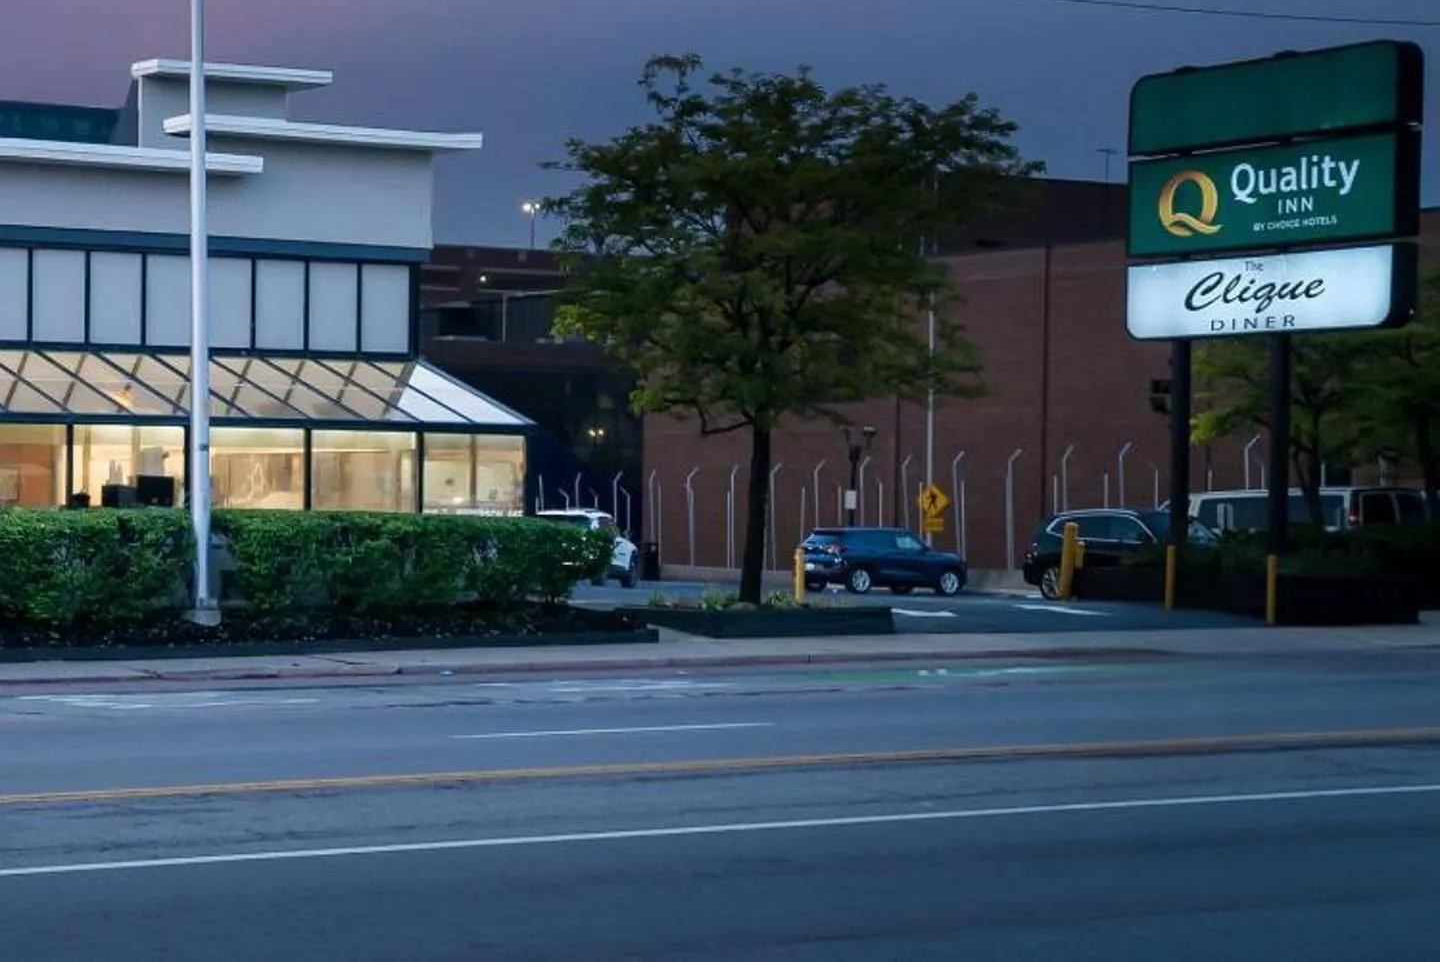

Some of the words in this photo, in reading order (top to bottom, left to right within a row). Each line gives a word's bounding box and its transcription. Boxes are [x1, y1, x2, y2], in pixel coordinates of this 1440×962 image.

[1230, 155, 1360, 204] Quality
[1159, 170, 1223, 236] Q
[1278, 196, 1314, 214] INN
[1253, 222, 1266, 232] BY
[1267, 218, 1301, 230] CHOICE
[1302, 215, 1337, 227] HOTELS
[1245, 261, 1264, 272] The
[1184, 272, 1325, 314] Clique
[1211, 315, 1296, 331] DINER
